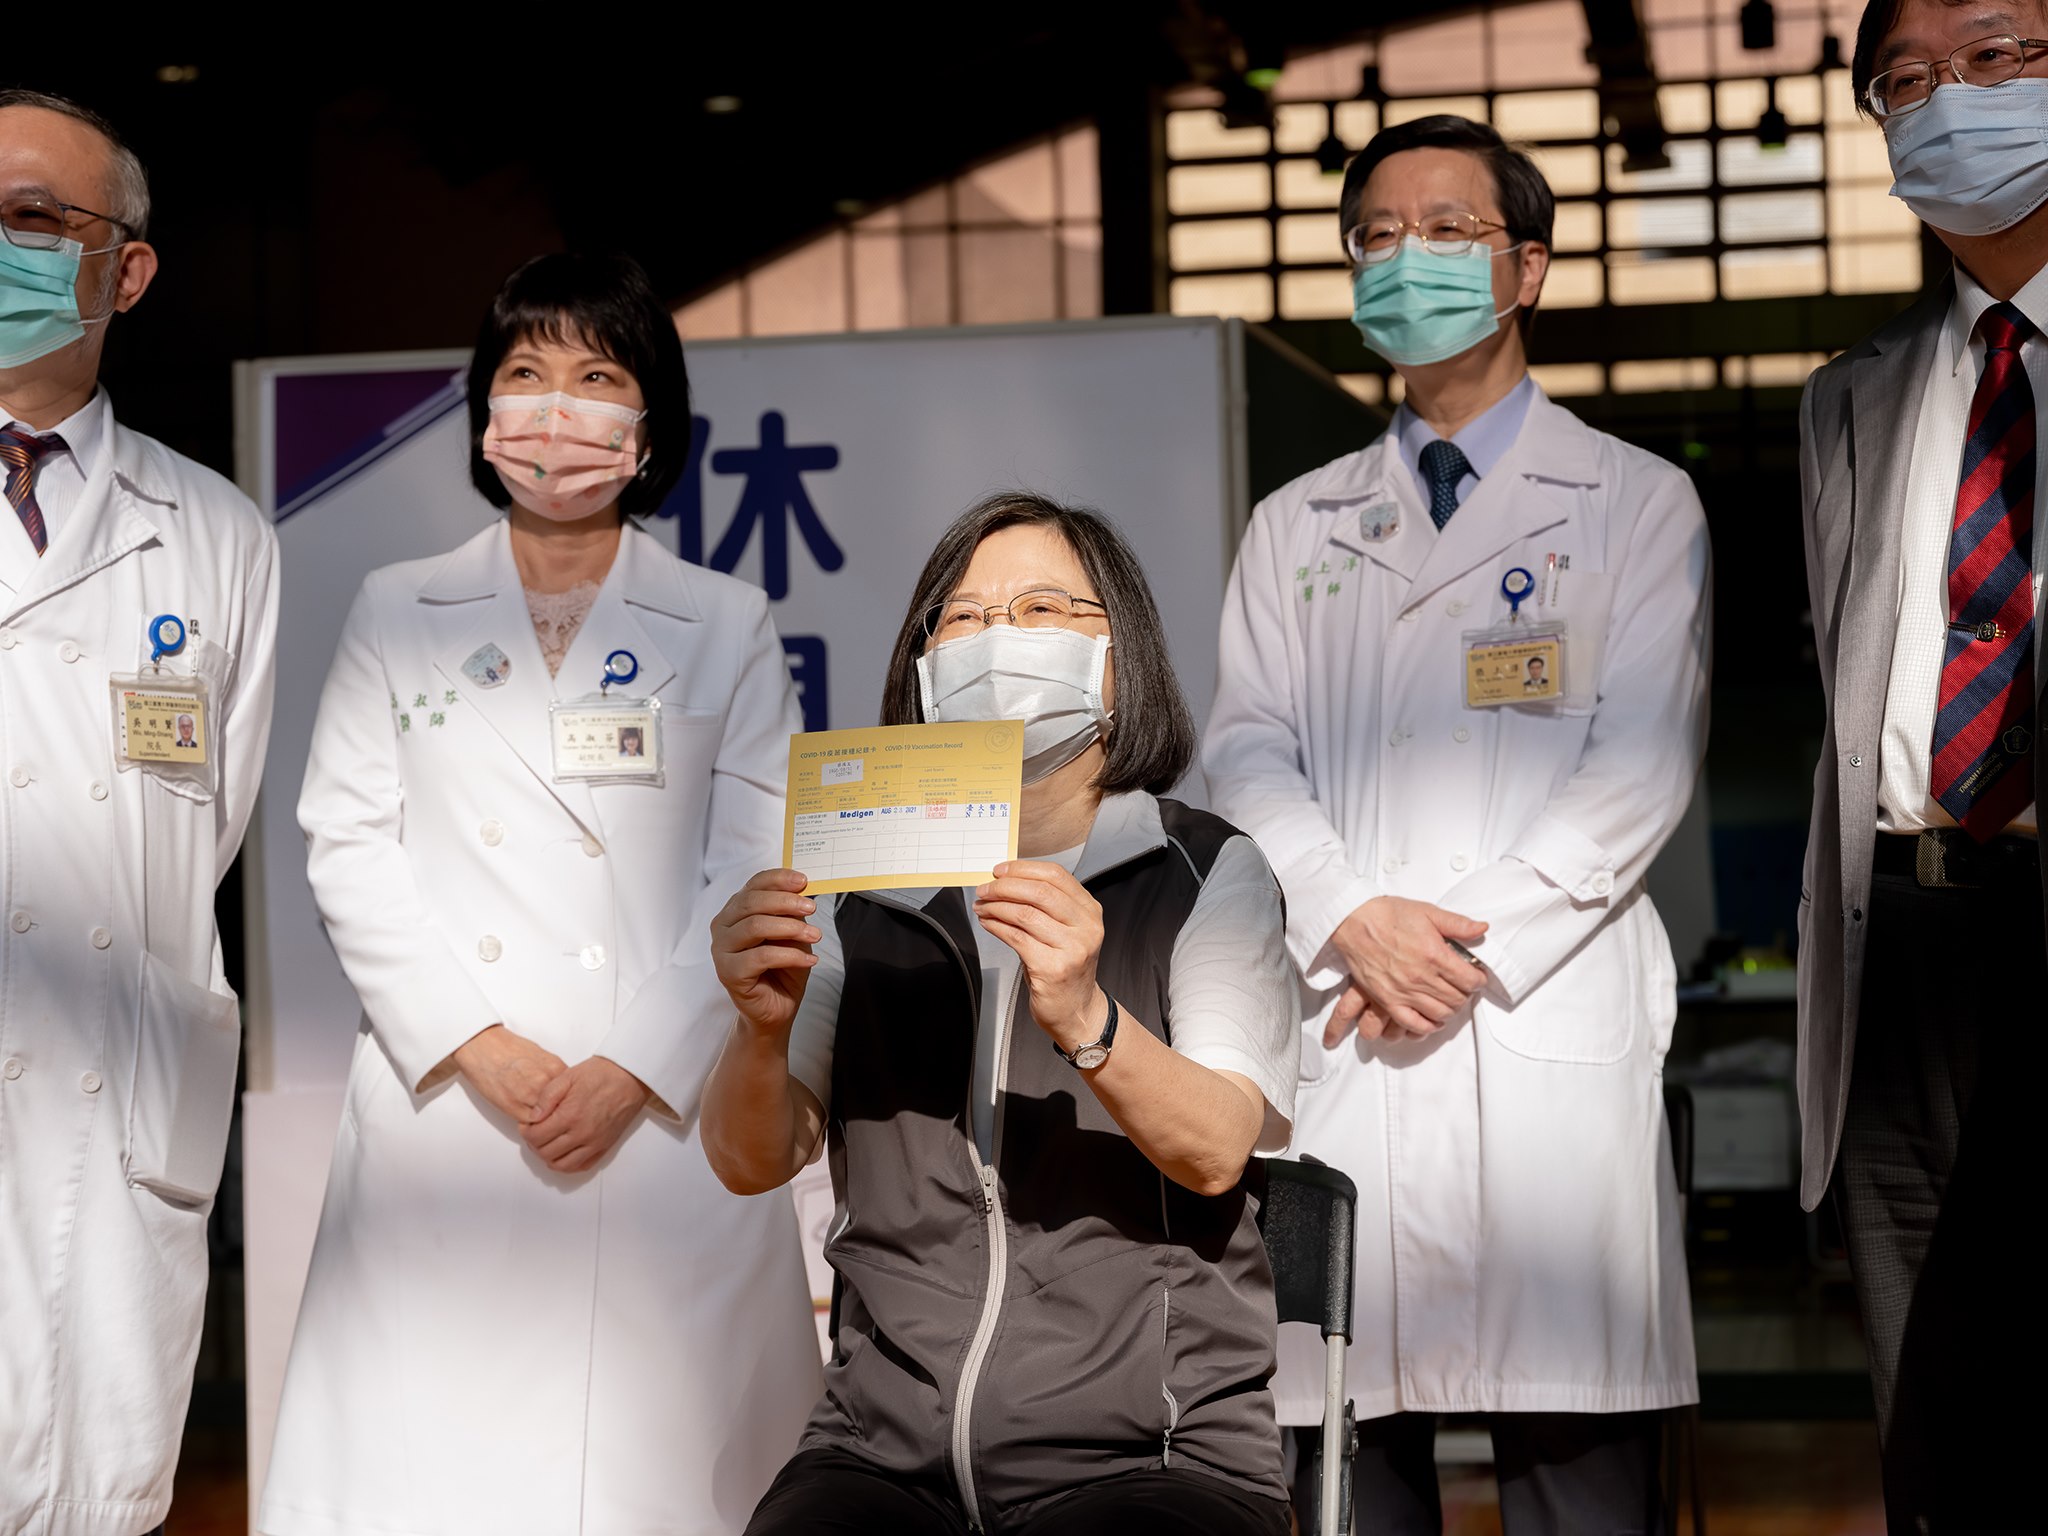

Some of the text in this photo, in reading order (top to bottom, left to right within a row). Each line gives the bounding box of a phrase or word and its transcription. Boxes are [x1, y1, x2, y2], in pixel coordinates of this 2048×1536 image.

[885, 741, 963, 752] COVID-19 Vaccination Record
[840, 809, 874, 819] Medigen
[881, 807, 892, 815] AUG
[905, 805, 917, 813] 2021
